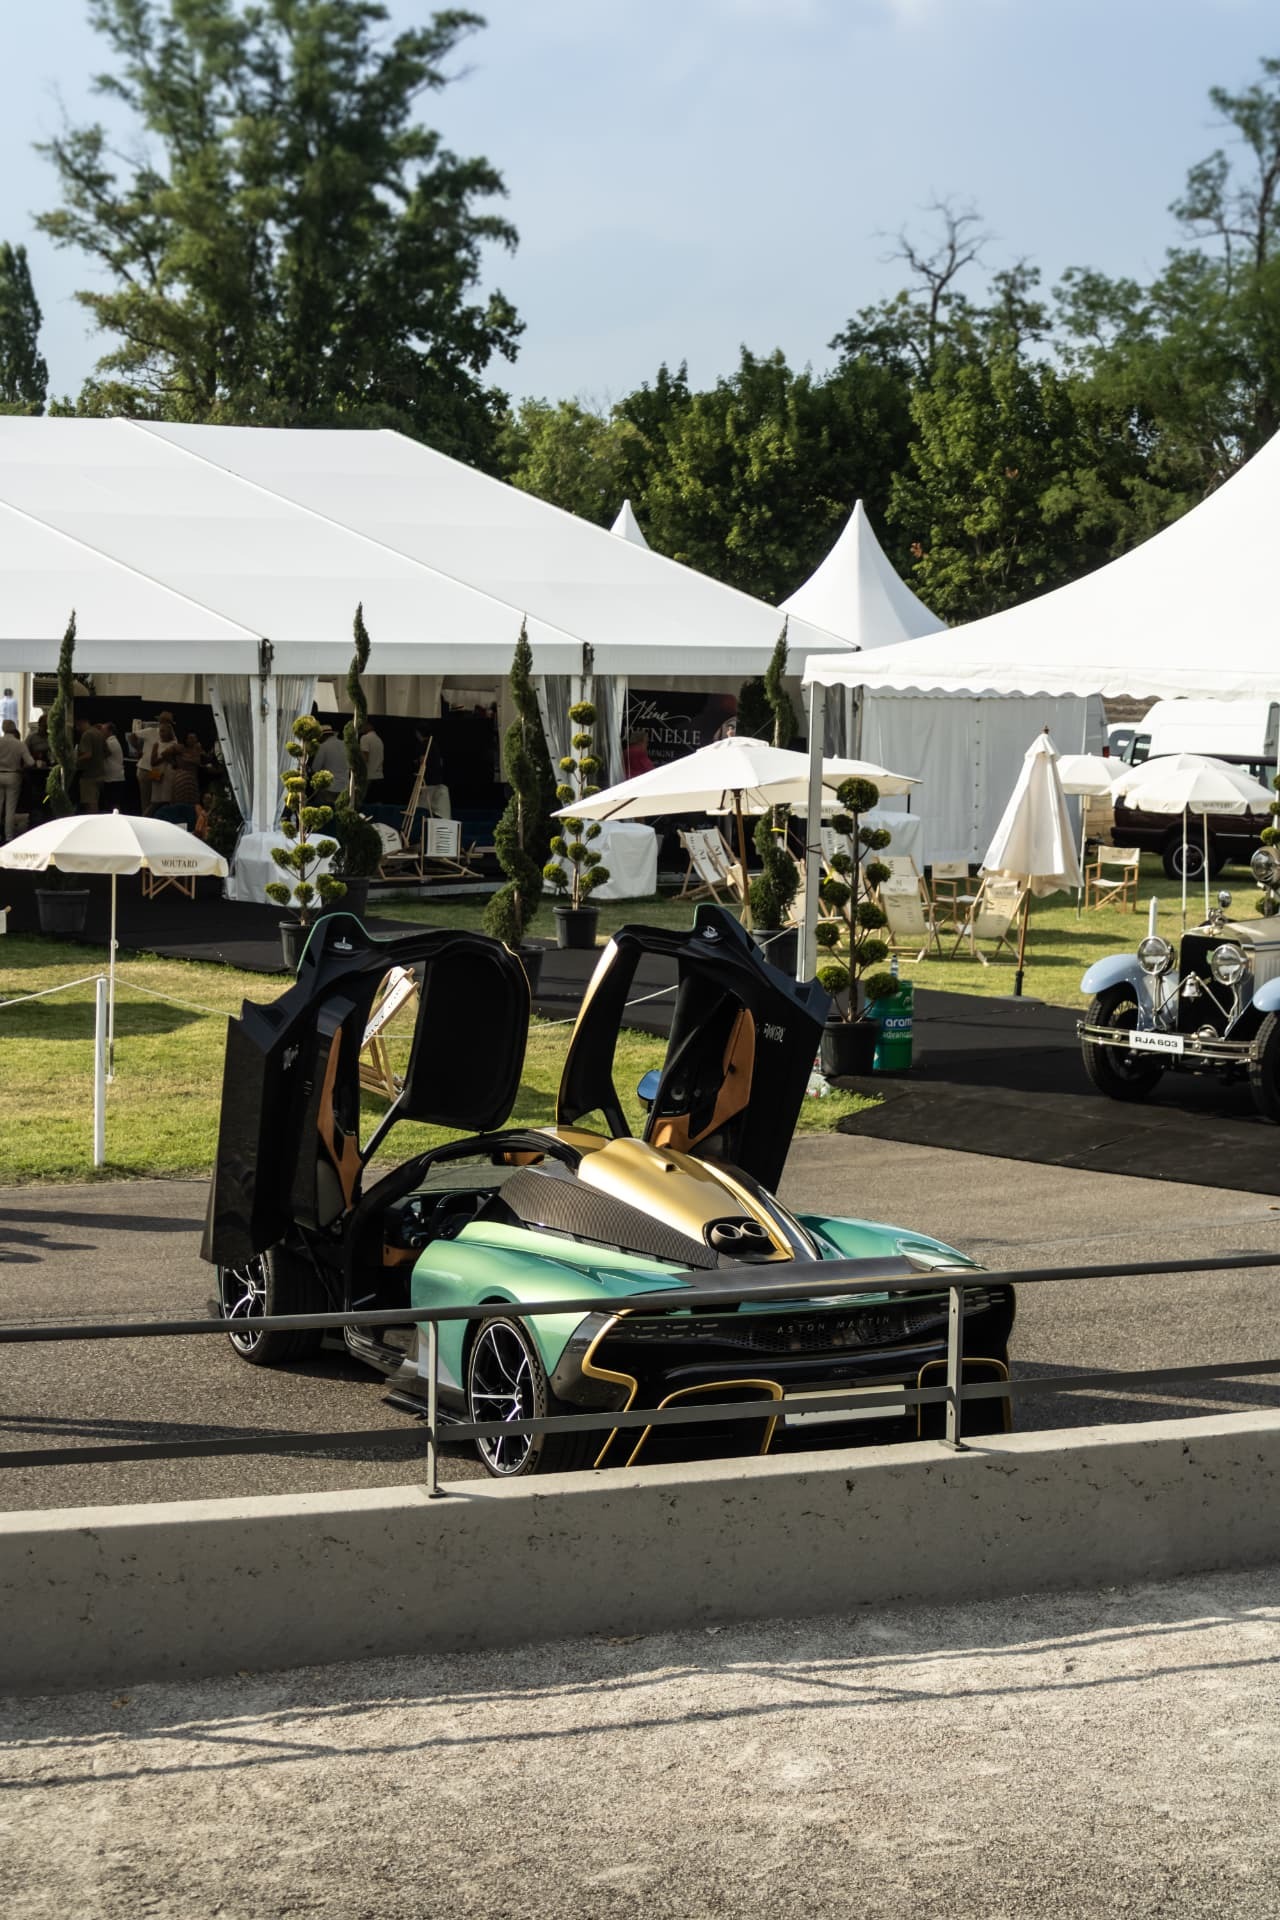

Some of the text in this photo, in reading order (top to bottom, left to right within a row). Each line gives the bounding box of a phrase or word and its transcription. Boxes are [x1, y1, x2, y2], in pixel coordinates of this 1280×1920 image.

[161, 858, 198, 869] MOUTARD
[777, 1317, 889, 1334] ASTON MARTIN
